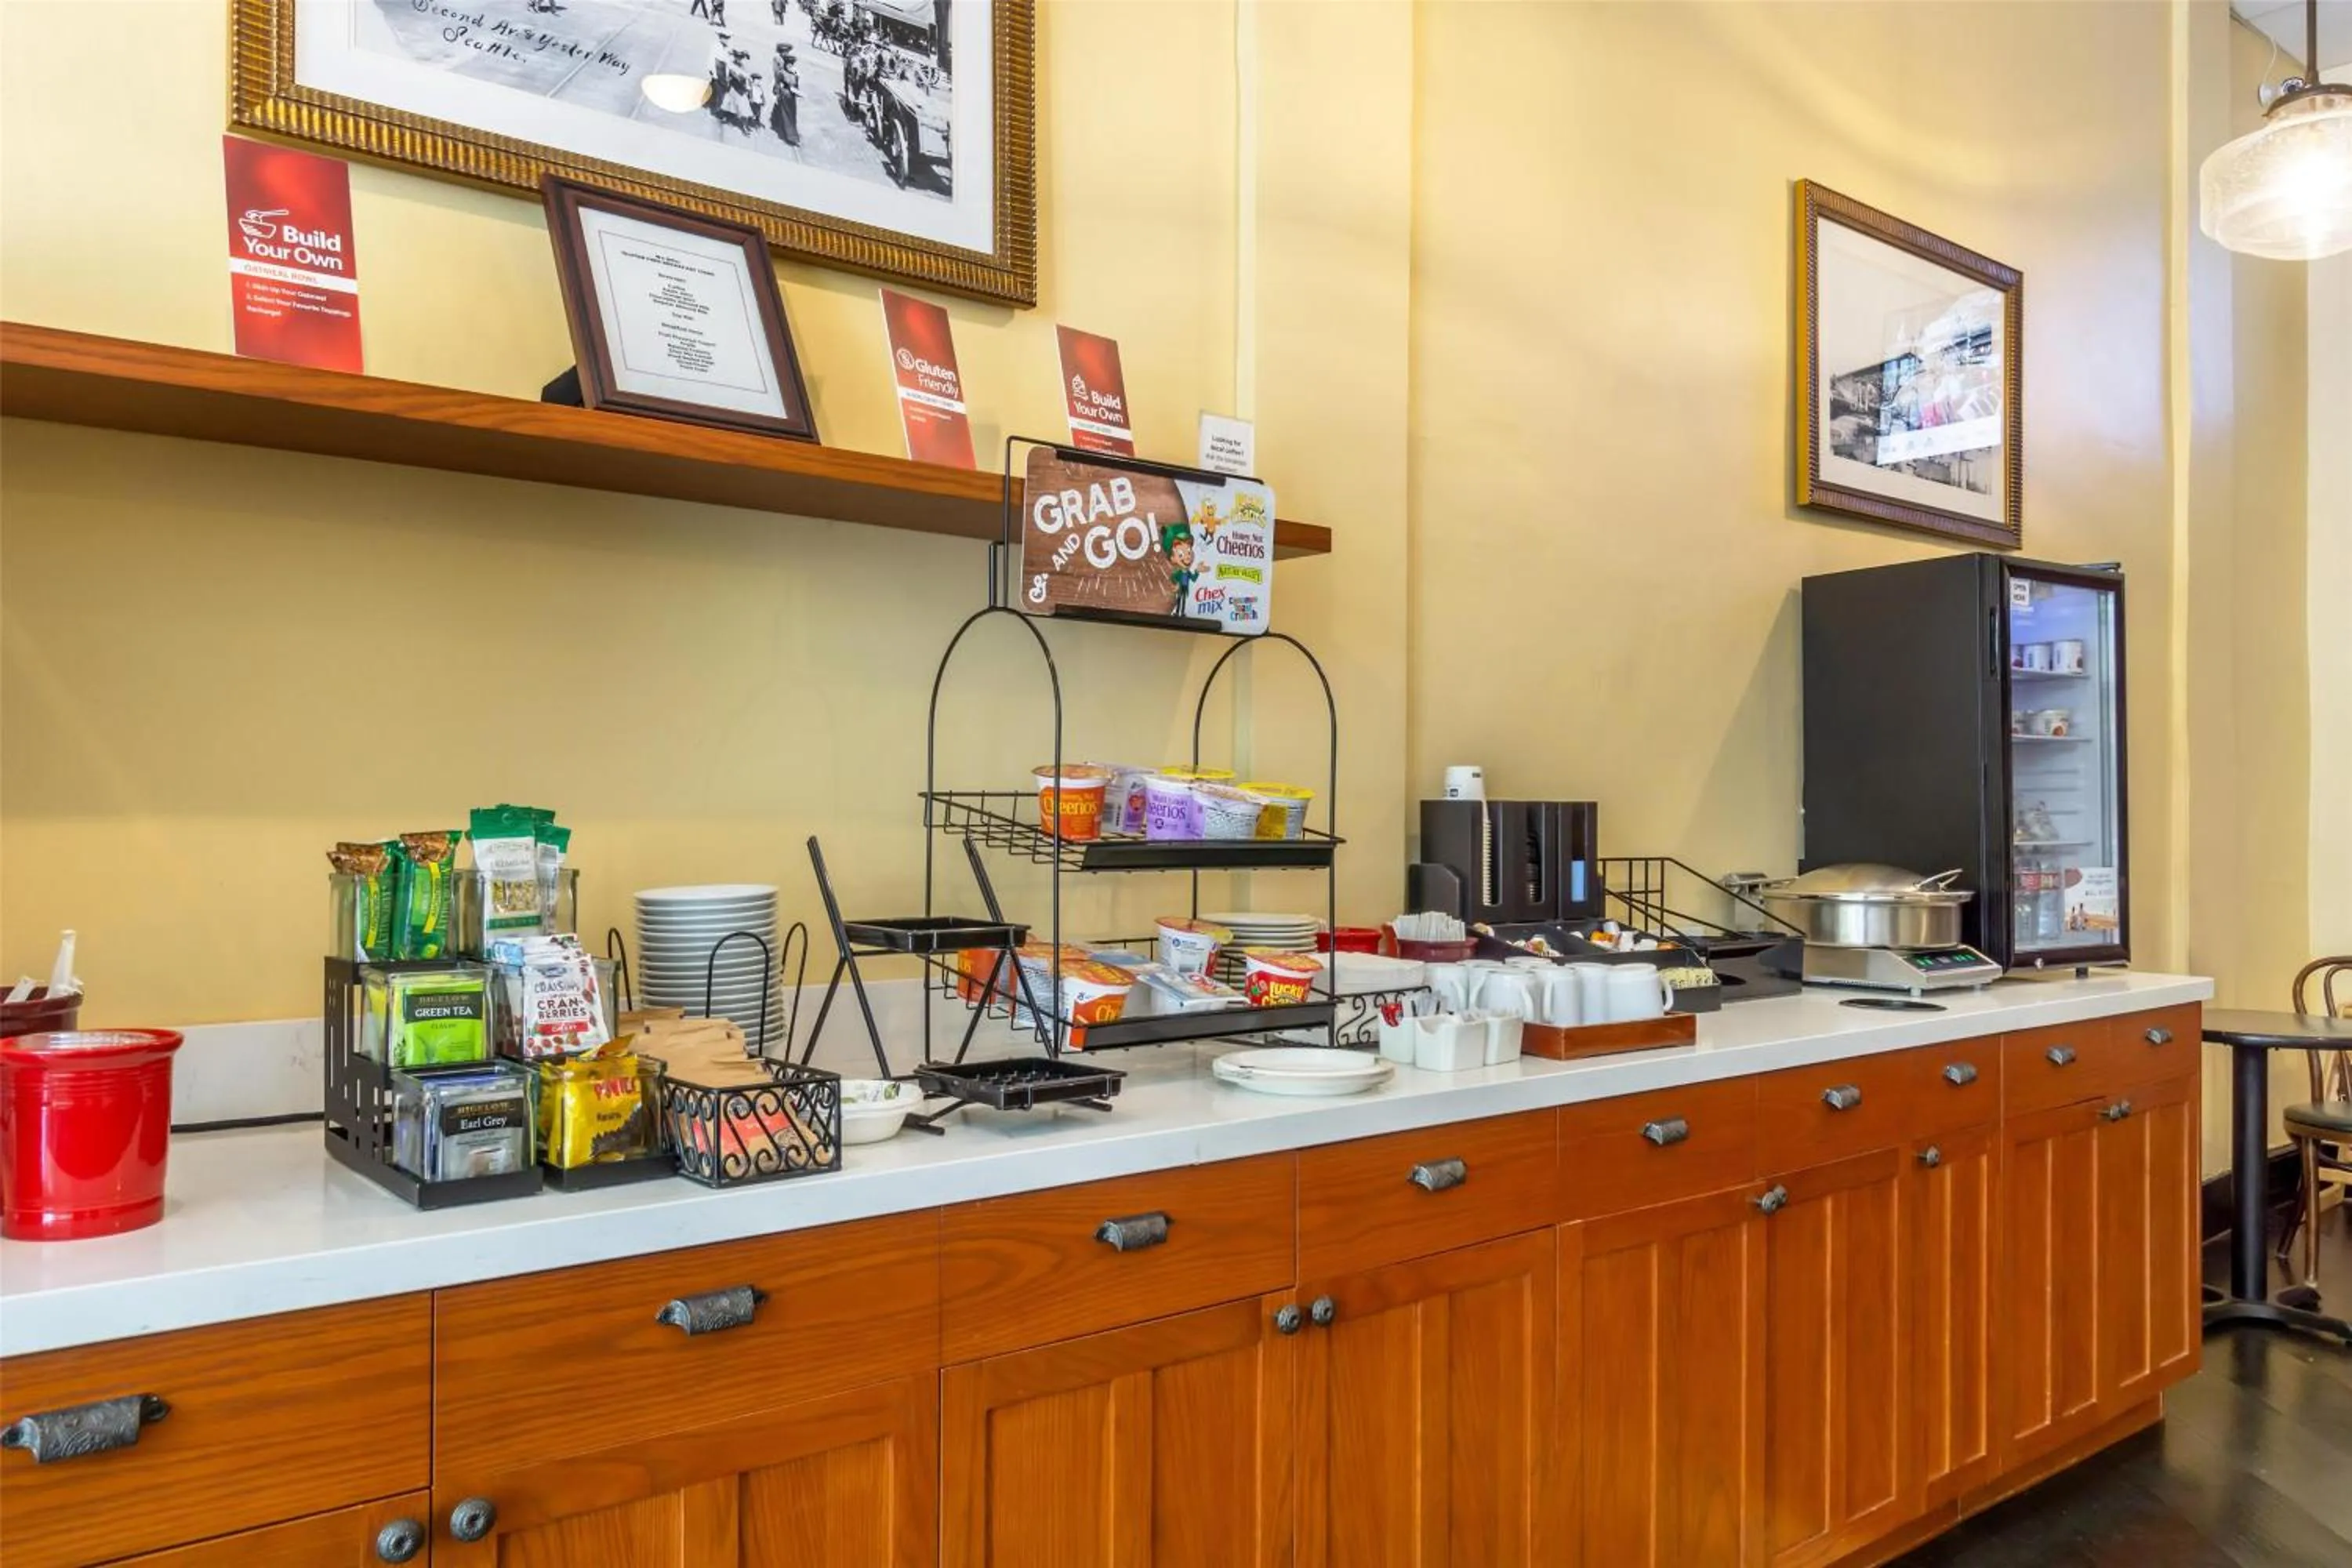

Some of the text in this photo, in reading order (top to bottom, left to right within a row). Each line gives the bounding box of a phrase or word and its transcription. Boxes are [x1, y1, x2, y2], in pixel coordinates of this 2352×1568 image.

[598, 51, 630, 76] Way
[282, 225, 341, 252] Build
[242, 235, 343, 270] Your Own
[916, 358, 956, 382] Gluten
[918, 375, 959, 398] Friendly
[1091, 390, 1122, 410] Build
[1073, 401, 1124, 424] Your Own
[1034, 477, 1136, 534] GRAB
[1084, 512, 1161, 569] GO!
[1216, 535, 1265, 559] Cheerios
[1051, 533, 1081, 572] AND
[1195, 586, 1227, 602] Chex
[415, 1006, 474, 1018] GREEN TEA
[537, 997, 584, 1011] CRAN-
[538, 1007, 587, 1020] BERRIES
[460, 1116, 507, 1129] Earl Grey
